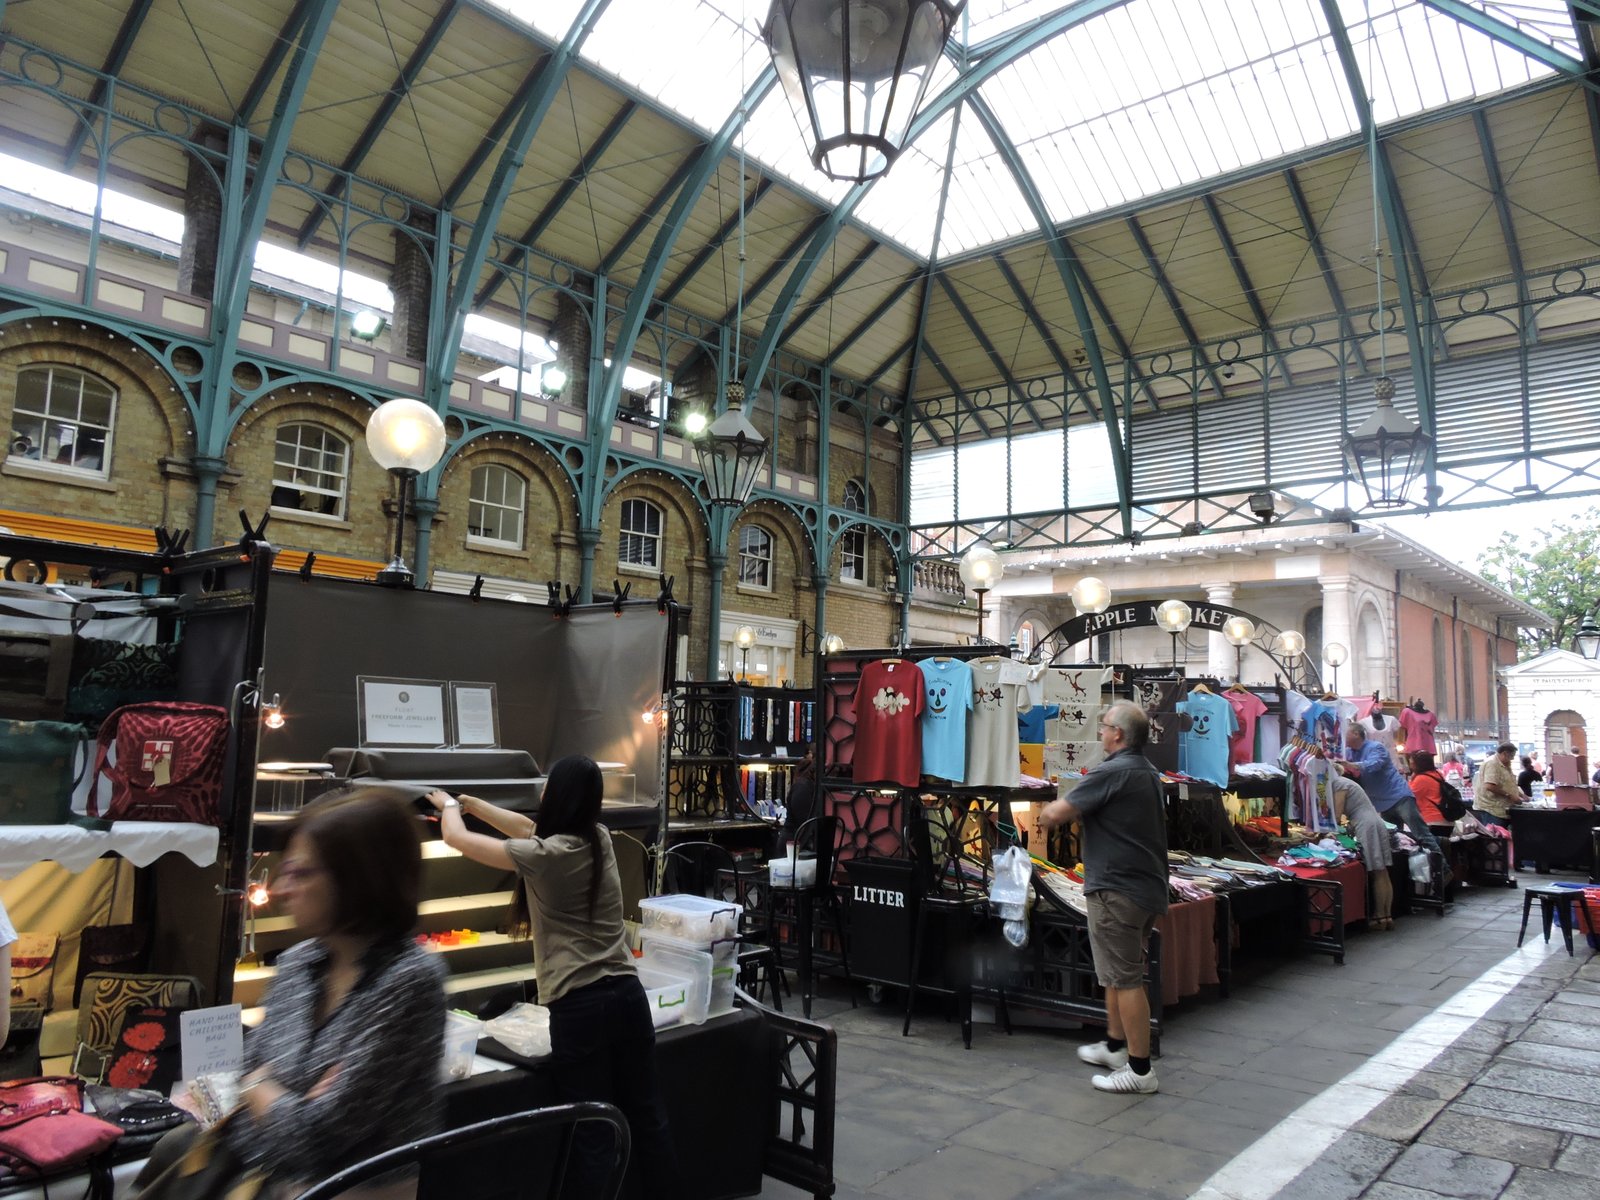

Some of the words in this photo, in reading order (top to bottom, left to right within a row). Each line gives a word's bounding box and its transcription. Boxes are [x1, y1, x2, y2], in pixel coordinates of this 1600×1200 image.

[1084, 608, 1136, 633] APPLE
[1150, 606, 1236, 626] MKET
[853, 885, 905, 908] LITTER
[189, 1016, 214, 1028] HAND
[217, 1012, 239, 1022] MADE
[189, 1022, 240, 1036] CHILDREN'S
[206, 1033, 227, 1043] BAGS
[215, 1056, 238, 1068] EACH
